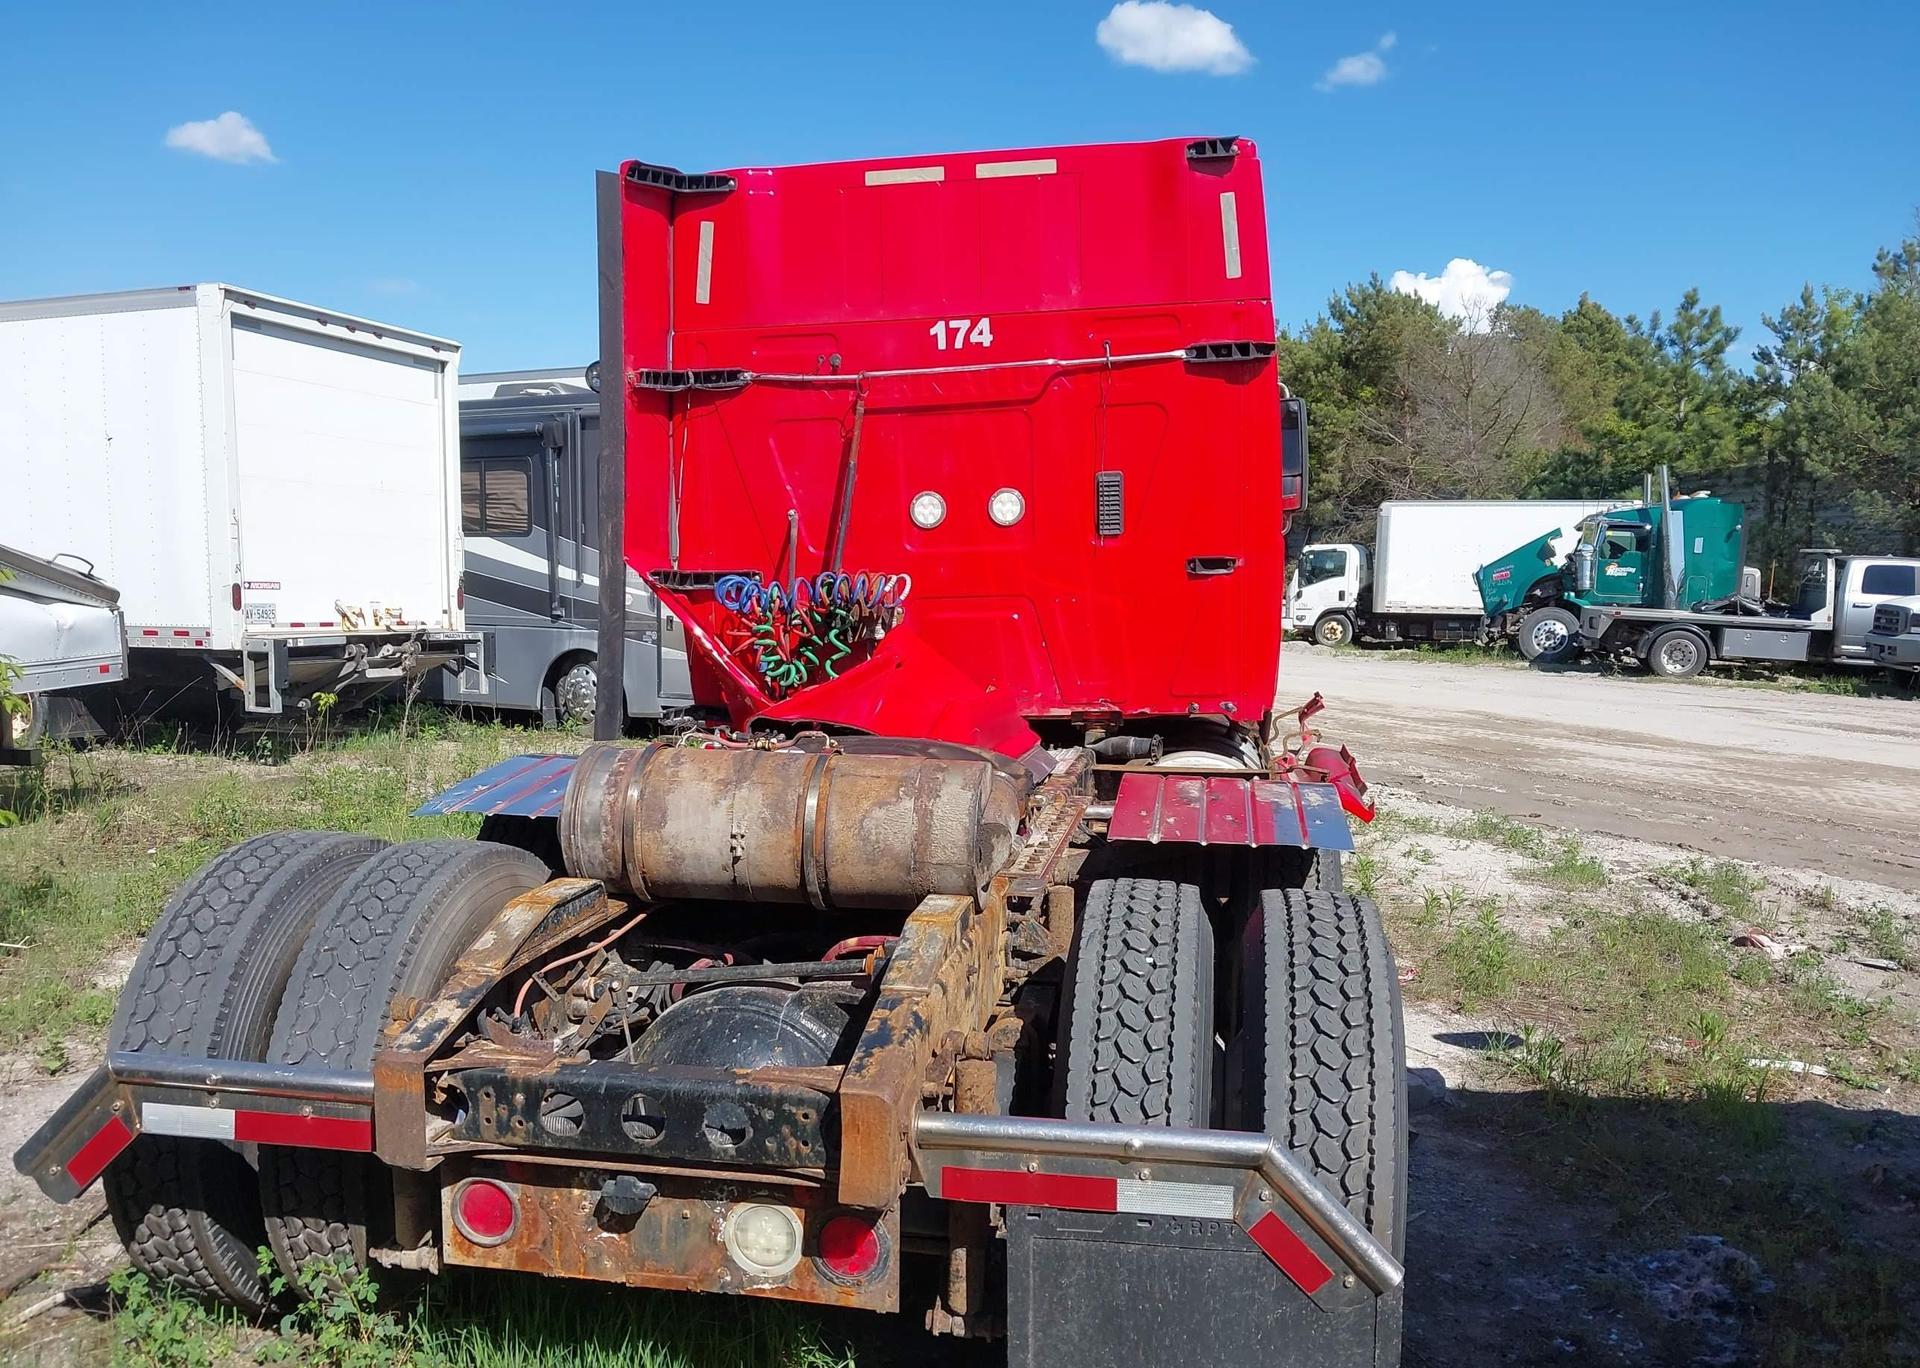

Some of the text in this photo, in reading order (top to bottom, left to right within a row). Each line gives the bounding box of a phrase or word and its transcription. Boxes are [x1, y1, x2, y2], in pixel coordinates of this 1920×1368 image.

[929, 317, 993, 350] 174
[249, 582, 280, 590] MORGAN
[245, 609, 276, 620] AV-54925
